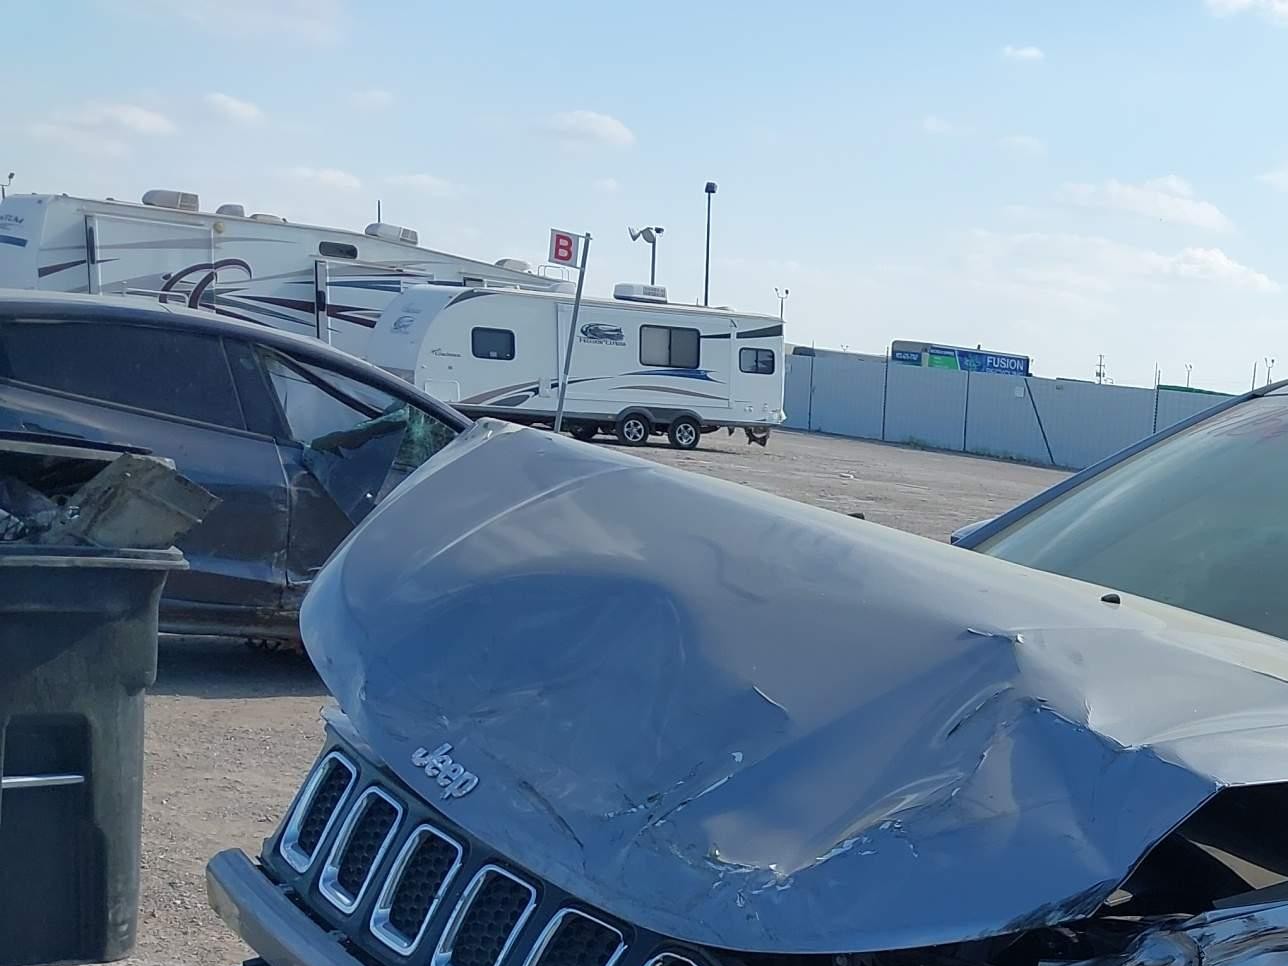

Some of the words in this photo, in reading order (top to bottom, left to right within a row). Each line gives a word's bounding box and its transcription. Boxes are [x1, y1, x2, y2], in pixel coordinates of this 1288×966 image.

[554, 234, 573, 261] B
[986, 356, 1024, 371] FUSION
[411, 742, 479, 800] Jeep
